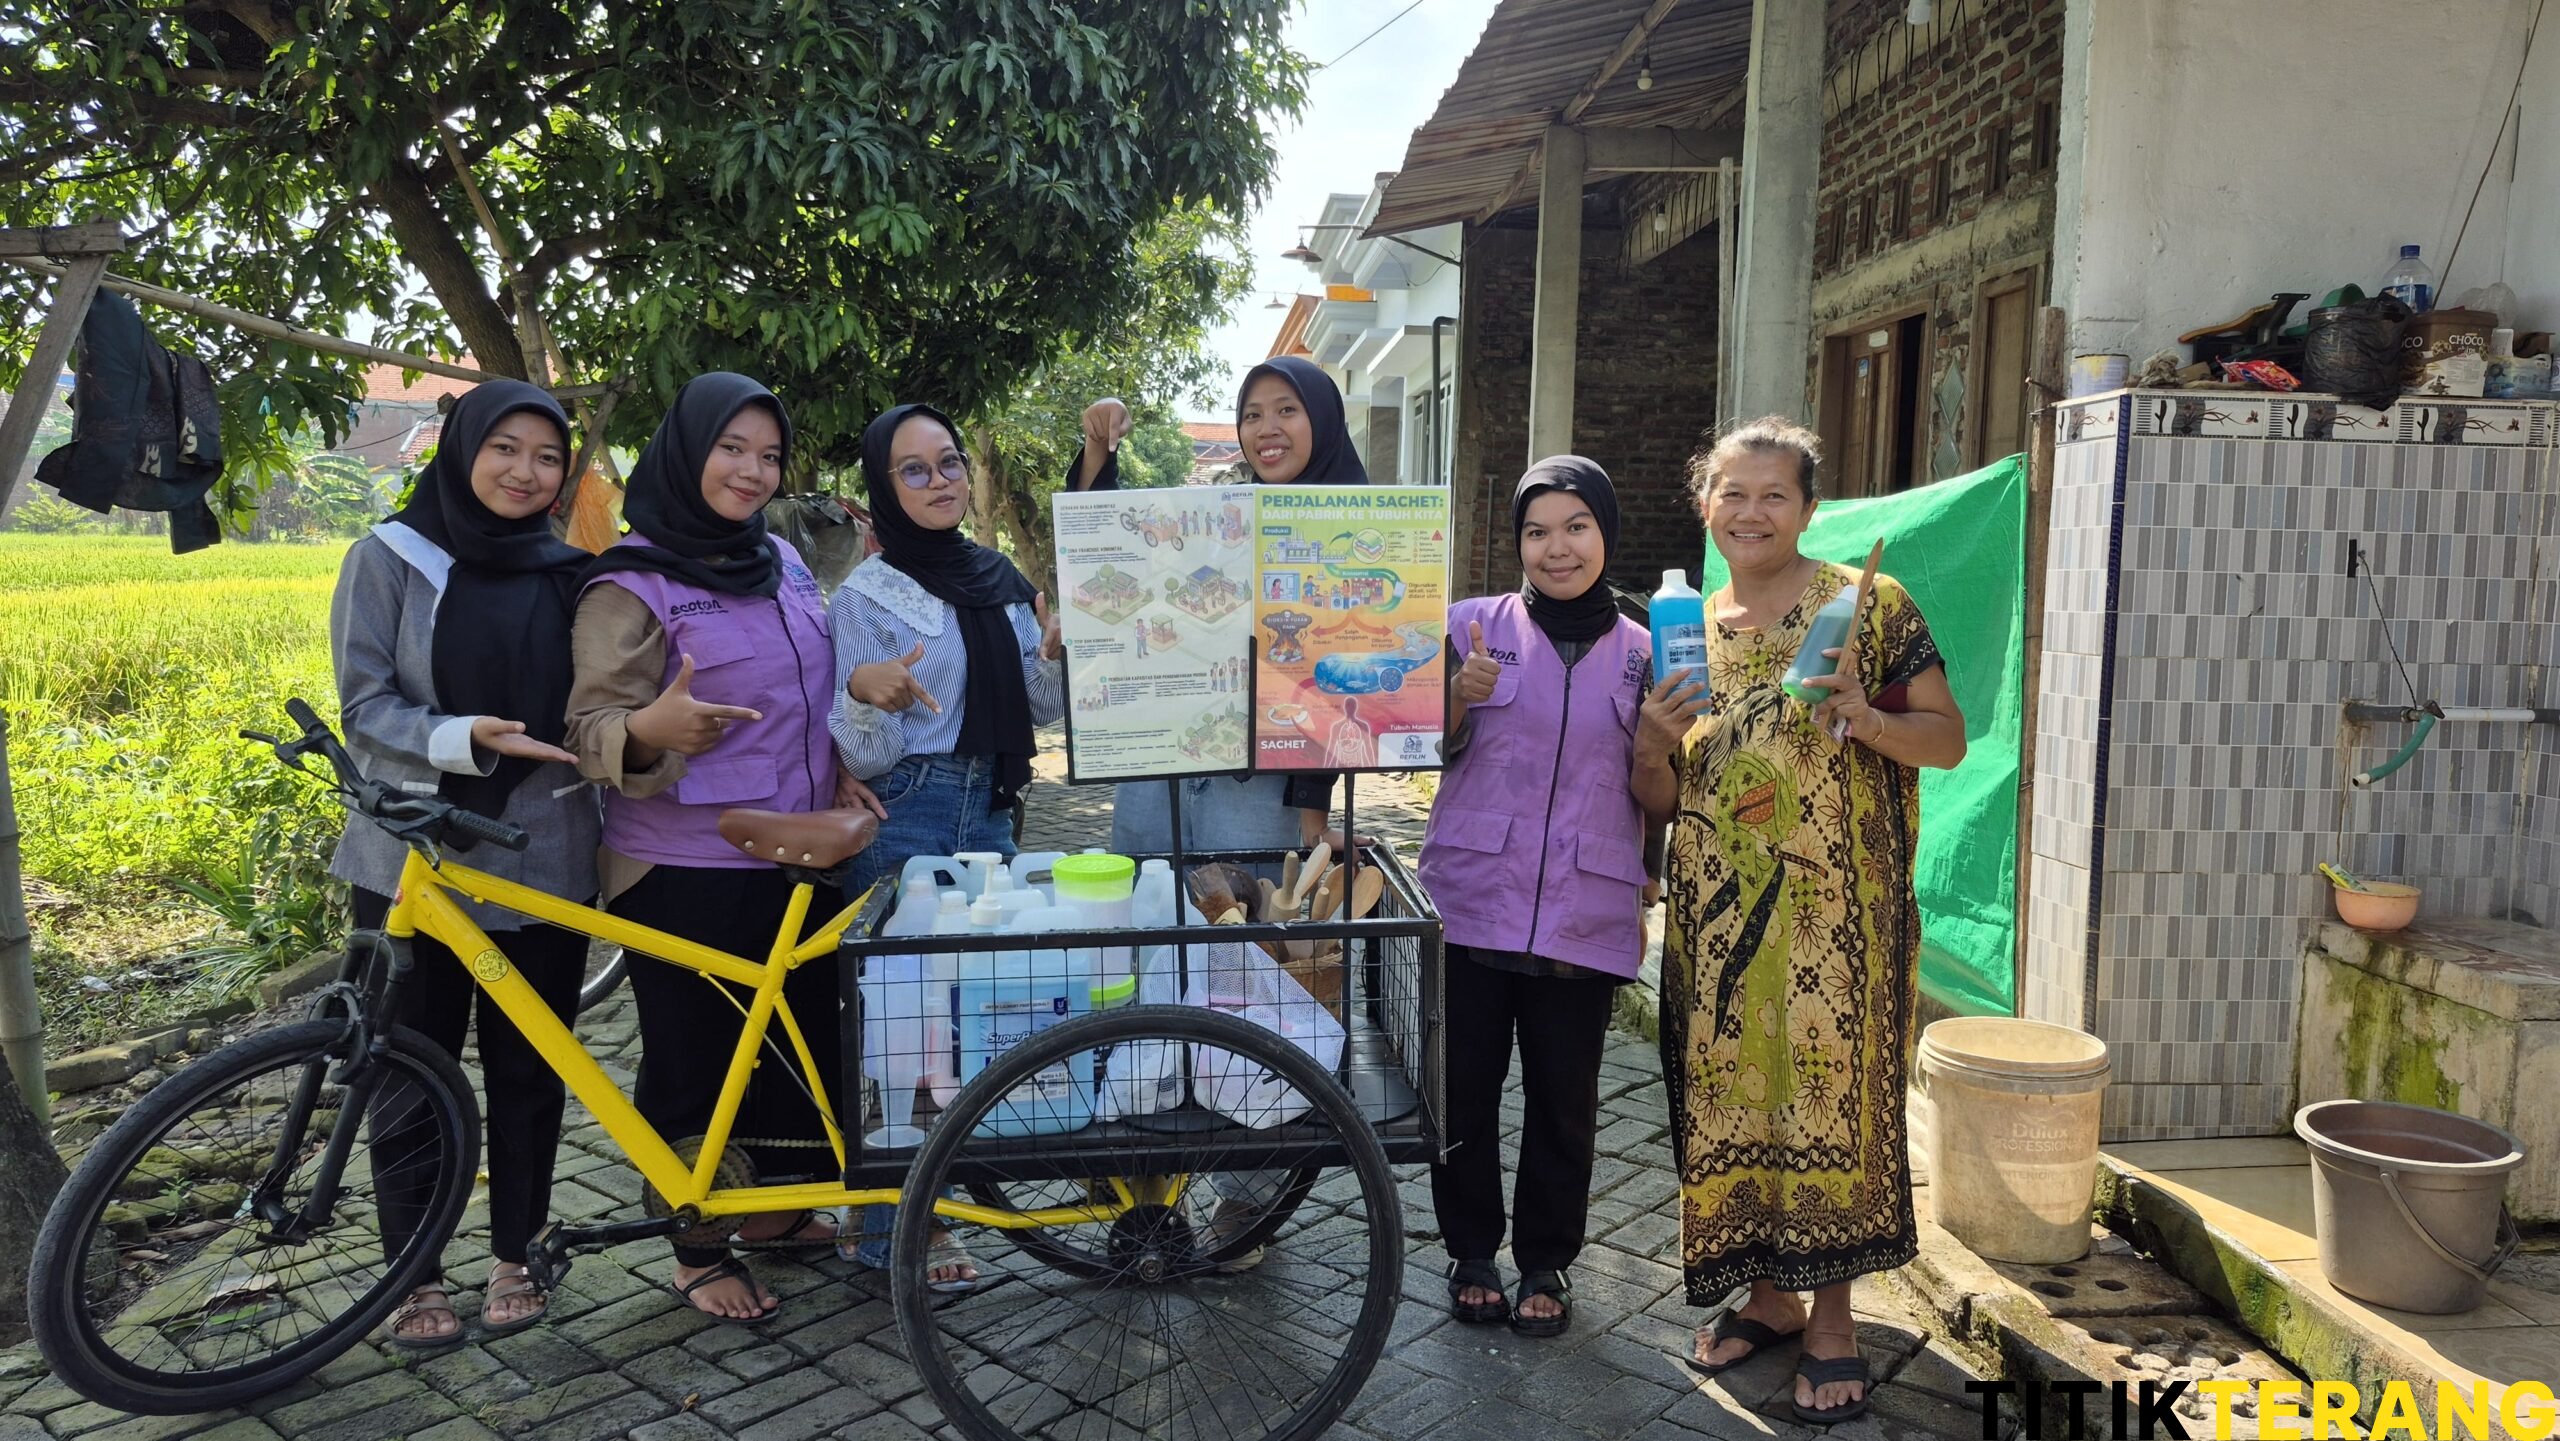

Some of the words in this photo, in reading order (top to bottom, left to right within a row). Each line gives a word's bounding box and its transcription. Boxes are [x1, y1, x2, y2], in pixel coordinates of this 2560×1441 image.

[2449, 334, 2484, 346] CHOCO
[1262, 495, 1371, 507] PERJALANAN
[1376, 495, 1444, 507] SACHET:
[1262, 509, 1293, 520] DARI
[1296, 509, 1345, 520] PABRIK
[1348, 509, 1364, 520] KE
[1368, 509, 1411, 520] TUBUH
[1415, 509, 1443, 520] KITA
[671, 599, 723, 616] ecoton
[1260, 740, 1307, 750] SACHET
[987, 1031, 1035, 1046] SuperP
[2012, 1122, 2068, 1139] Dulux
